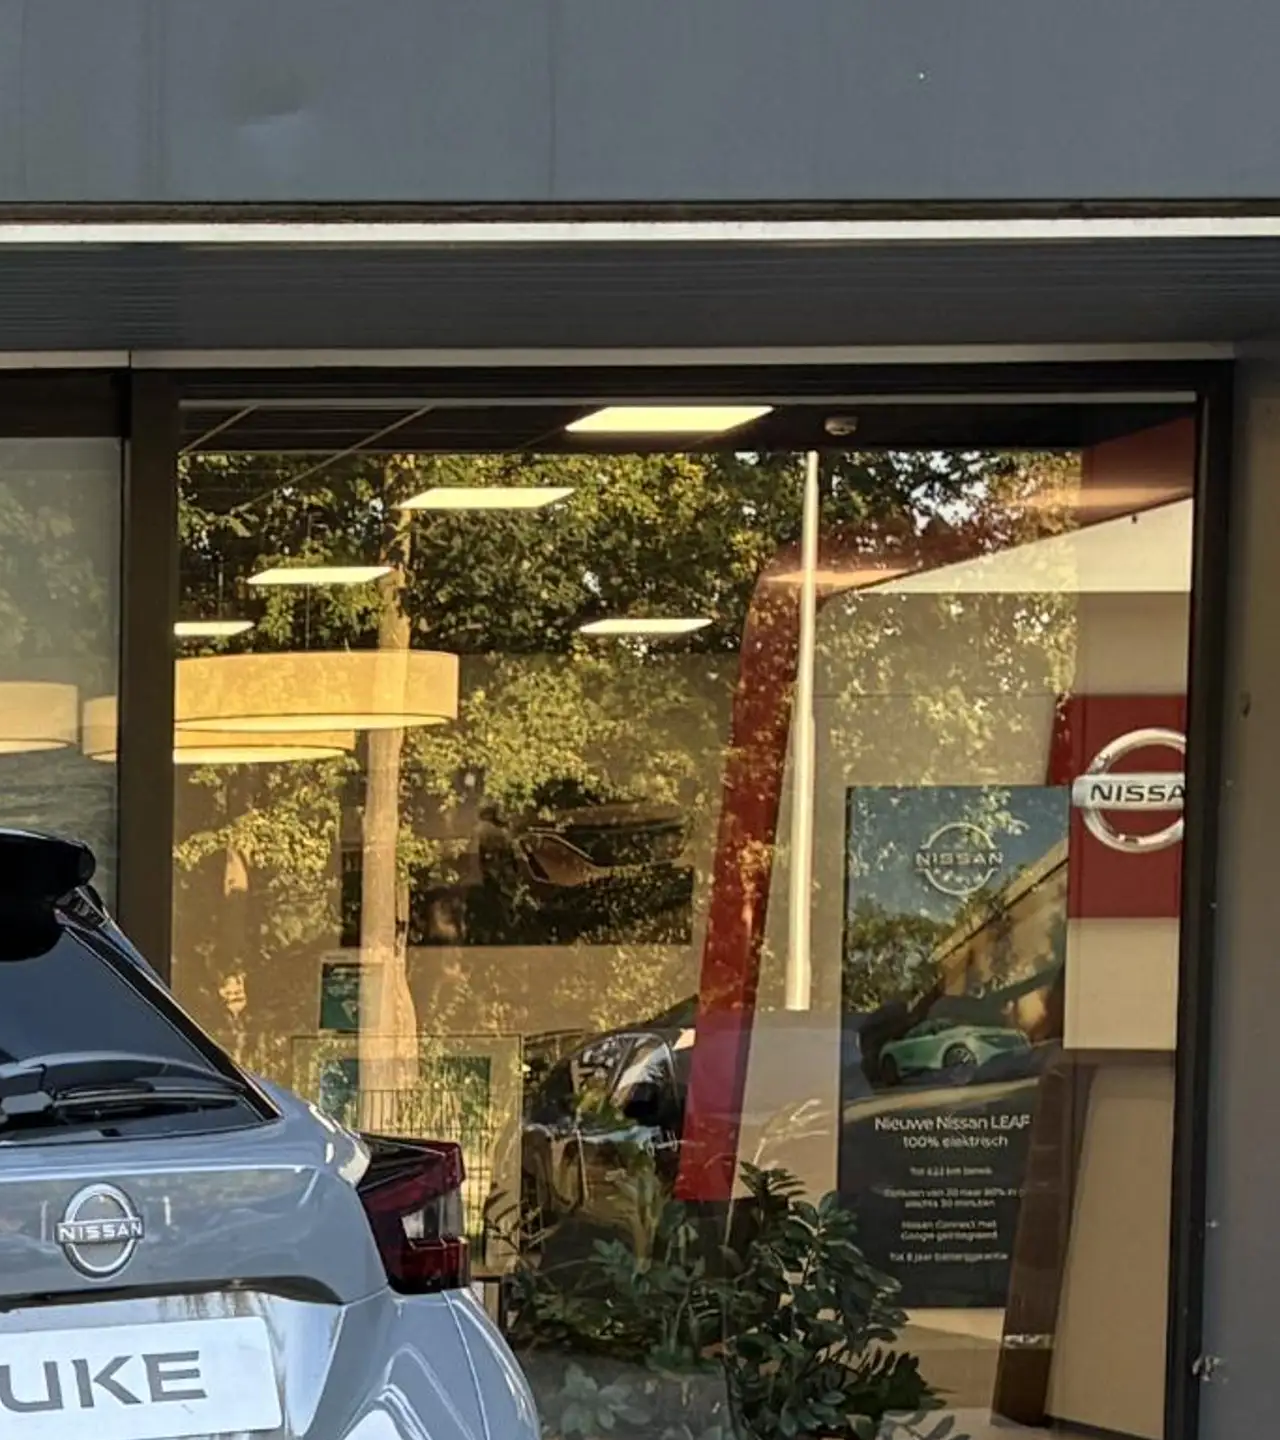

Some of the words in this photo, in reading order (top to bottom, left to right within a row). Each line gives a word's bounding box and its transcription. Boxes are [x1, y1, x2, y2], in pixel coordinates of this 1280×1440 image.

[1090, 784, 1185, 803] NISSA
[915, 852, 1005, 866] NISSAN
[874, 1115, 934, 1131] Nieuwe
[937, 1115, 989, 1131] Nissan
[991, 1114, 1032, 1130] LEAF
[903, 1136, 941, 1149] 100%
[58, 1221, 143, 1242] NISSAN
